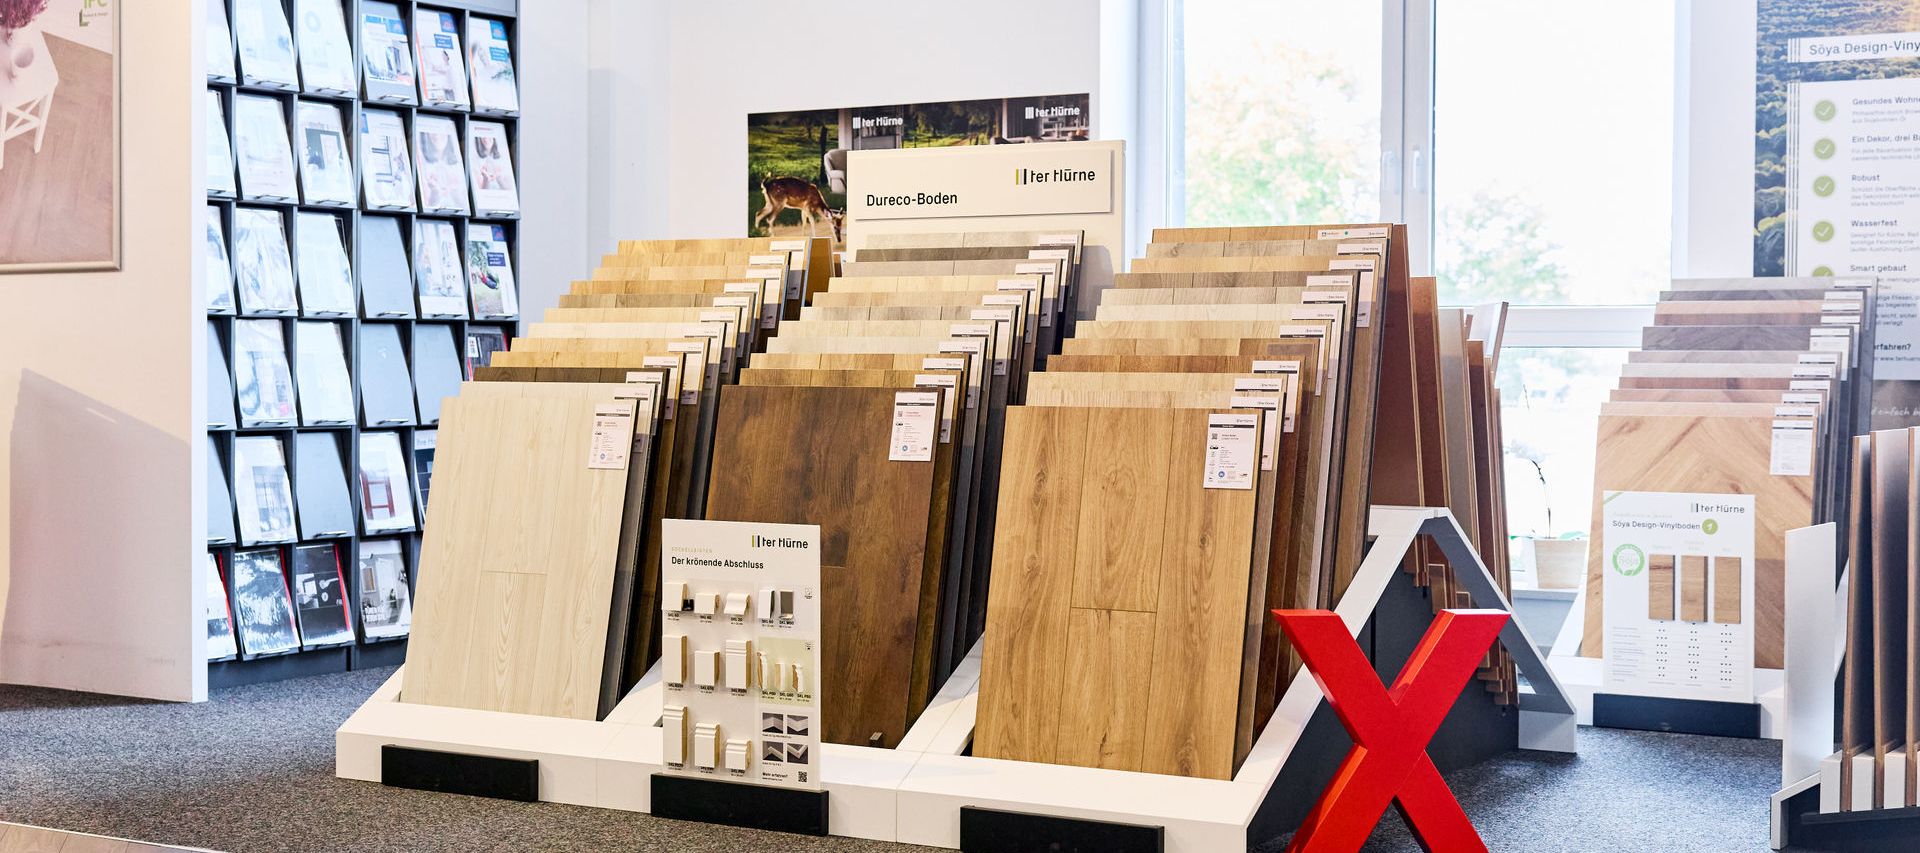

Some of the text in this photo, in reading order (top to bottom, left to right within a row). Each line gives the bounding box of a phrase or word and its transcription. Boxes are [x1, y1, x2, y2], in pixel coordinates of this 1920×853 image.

[1852, 97, 1892, 105] Gesundes
[1035, 108, 1050, 117] ter
[862, 118, 875, 127] ter
[1866, 135, 1892, 143] Dekor,
[1894, 134, 1910, 142] drei
[1030, 170, 1050, 183] ter
[1851, 174, 1880, 182] Robust
[866, 191, 958, 207] Dureco-Boden
[1851, 219, 1898, 227] Wasserfest
[1877, 265, 1907, 273] gebaut
[1700, 504, 1714, 513] ter
[1632, 521, 1700, 530] Design-Vinylboden
[762, 537, 776, 547] ter
[671, 556, 764, 569] Der krönende Abschluss
